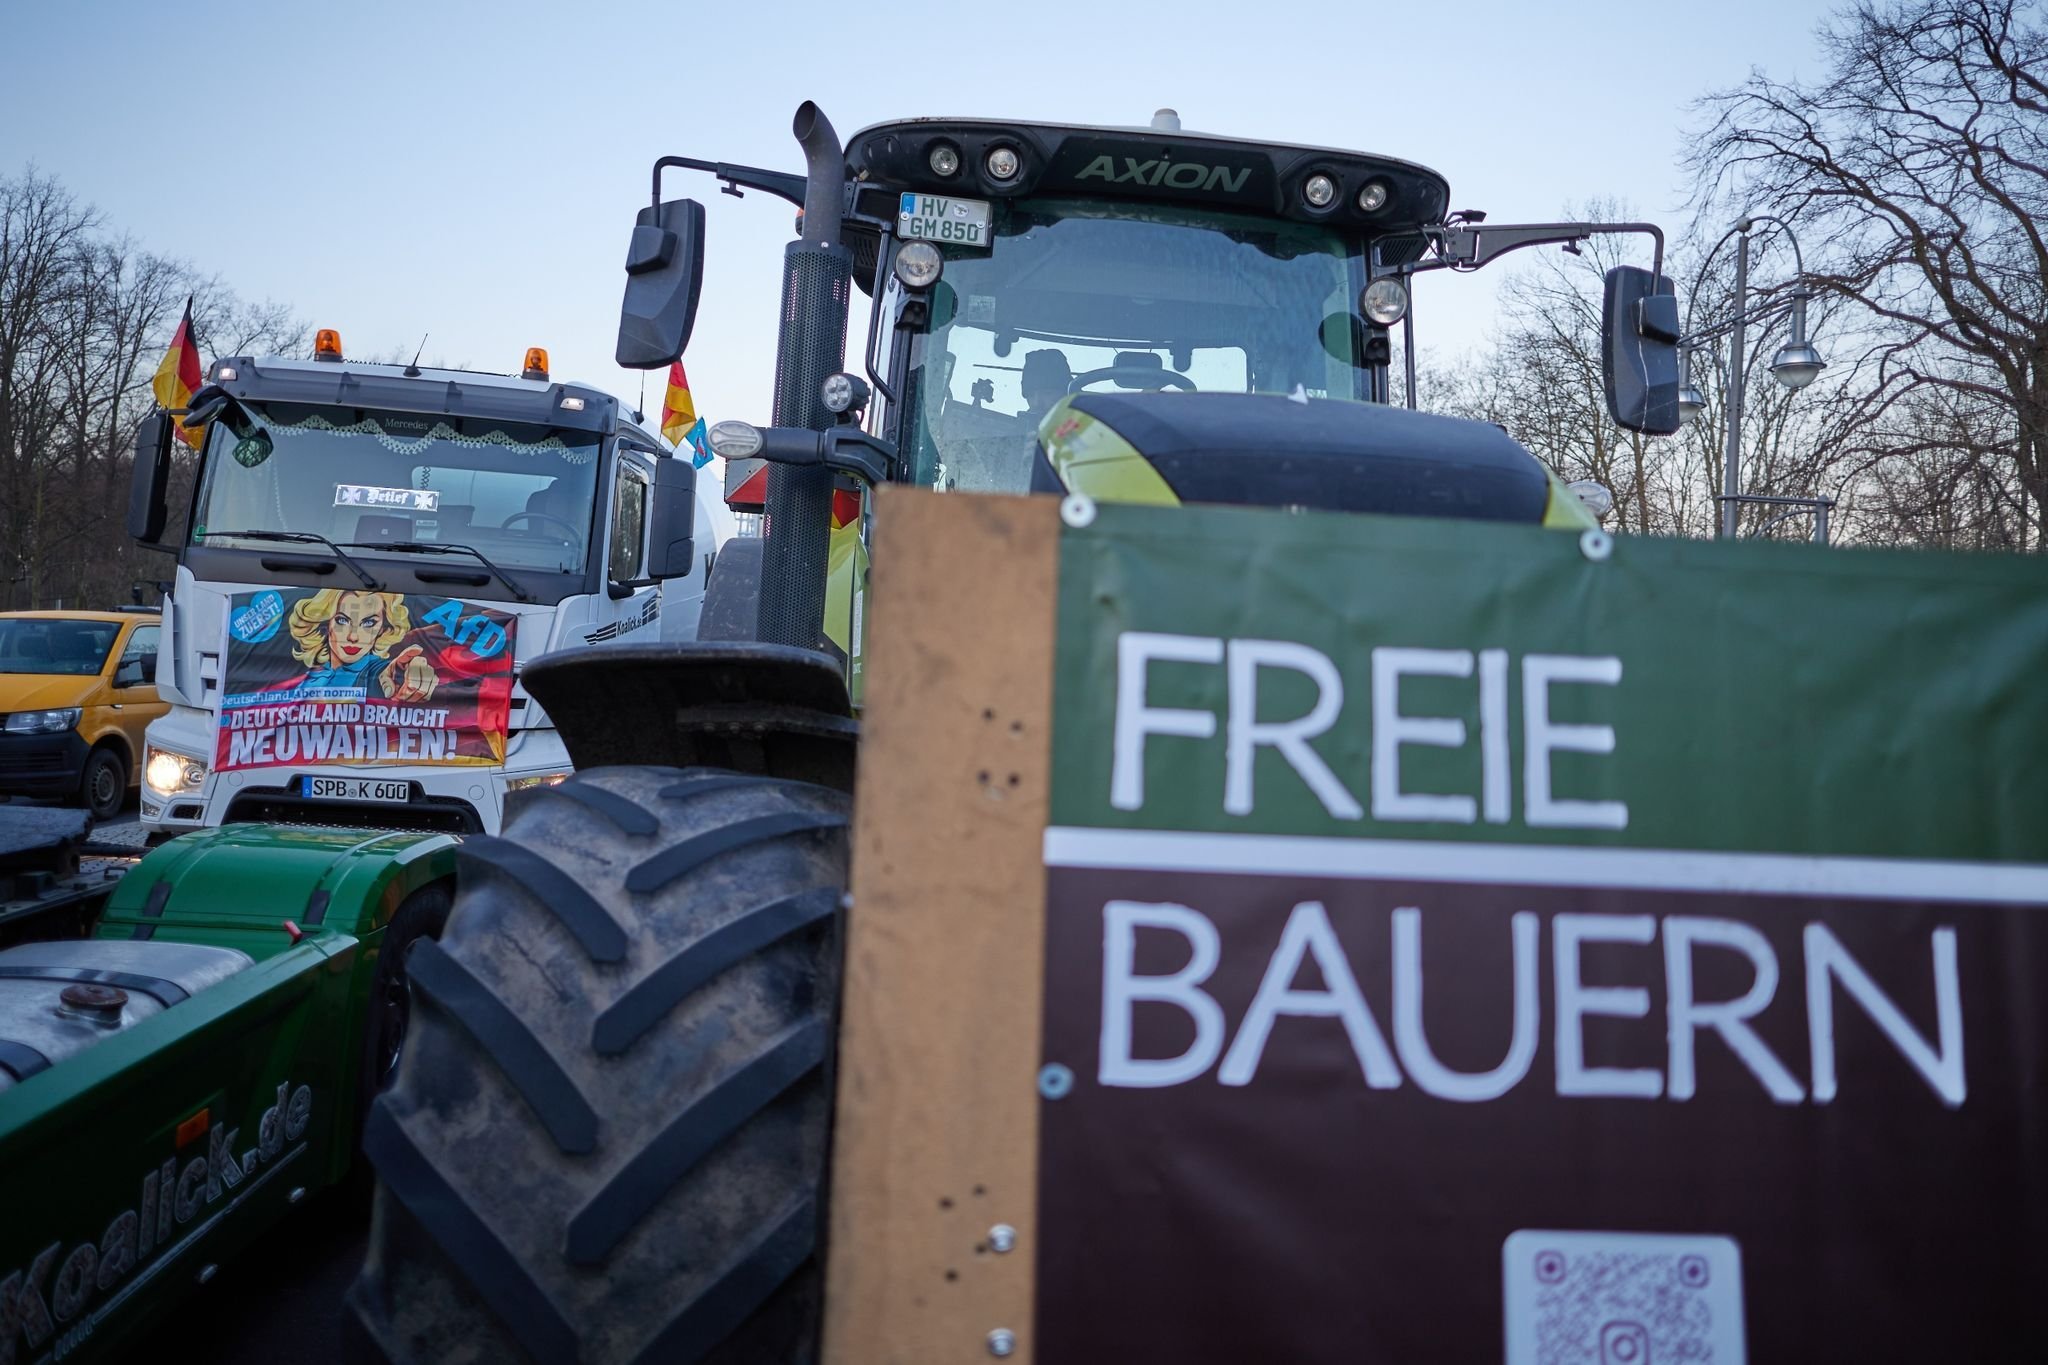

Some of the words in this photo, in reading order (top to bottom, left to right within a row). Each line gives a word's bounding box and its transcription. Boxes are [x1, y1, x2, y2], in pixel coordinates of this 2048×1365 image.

[1074, 155, 1252, 193] AXION
[921, 197, 948, 217] HV
[910, 217, 937, 237] GM
[941, 220, 979, 242] 850
[385, 418, 429, 431] Mercedes
[233, 607, 256, 628] UNSER
[255, 594, 275, 612] LAND
[238, 602, 281, 639] ZUERST!
[422, 599, 507, 658] AfD
[294, 687, 321, 698] Aber
[230, 703, 361, 730] DEUTSCHLAND
[363, 705, 450, 728] BRAUCHT
[1109, 631, 1629, 830] FREIE
[227, 725, 458, 767] NEUWAHLEN!
[313, 779, 347, 797] SPB
[359, 782, 370, 798] K
[374, 783, 407, 800] 600
[1096, 899, 1967, 1107] BAUERN
